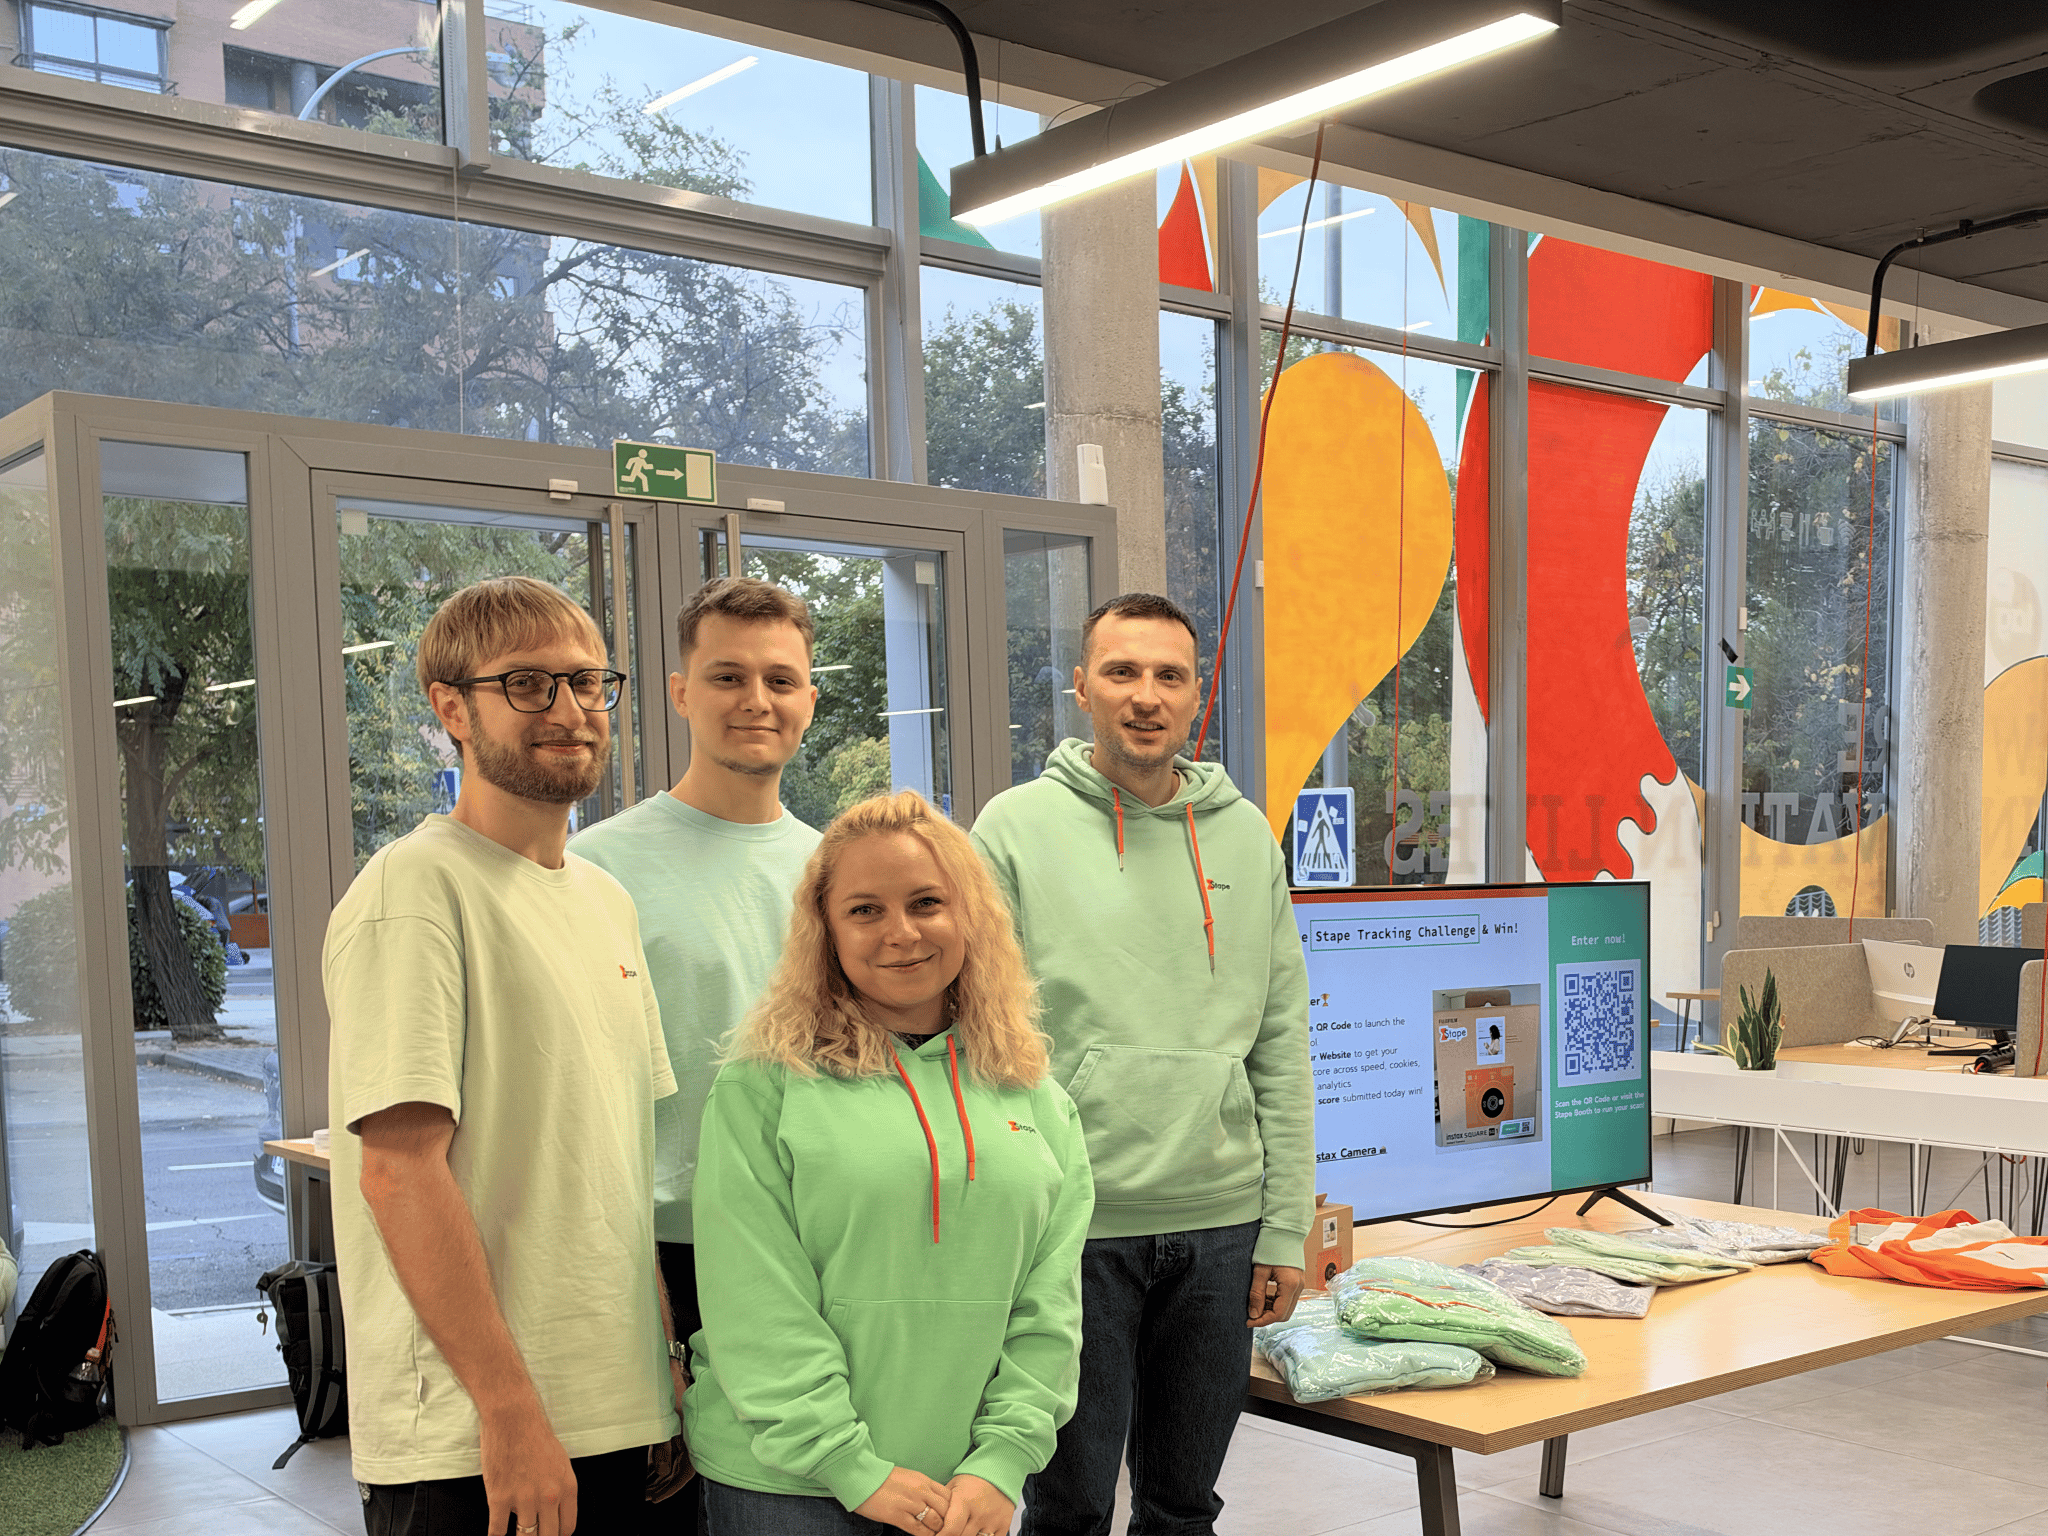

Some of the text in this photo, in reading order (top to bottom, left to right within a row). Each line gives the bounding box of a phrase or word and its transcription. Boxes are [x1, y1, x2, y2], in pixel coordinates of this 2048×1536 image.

[1210, 880, 1230, 891] Stape
[1316, 931, 1350, 944] Stape
[1357, 926, 1411, 942] Tracking
[1418, 925, 1476, 938] Challenge
[1482, 924, 1489, 934] &
[1494, 922, 1518, 934] Win!
[1571, 933, 1626, 946] Enter now!
[1316, 1022, 1328, 1032] QR
[1331, 1020, 1352, 1031] Code
[1354, 1021, 1363, 1029] to
[1365, 1018, 1390, 1028] launch
[1393, 1017, 1406, 1026] the
[1444, 1029, 1467, 1040] Stape
[1319, 1051, 1352, 1061] Website
[1365, 1049, 1378, 1059] get
[1381, 1047, 1398, 1057] your
[1333, 1065, 1358, 1075] across
[1360, 1061, 1387, 1073] speed,
[1389, 1059, 1420, 1069] cookies,
[1317, 1080, 1352, 1091] analytics
[1318, 1087, 1423, 1105] score submitted today win!
[1555, 1100, 1570, 1108] Scan
[1571, 1098, 1582, 1106] the
[1594, 1095, 1611, 1103] Code
[1620, 1092, 1633, 1100] visit
[1634, 1091, 1645, 1099] the
[1555, 1111, 1573, 1119] Stape
[1574, 1108, 1593, 1116] Booth
[1615, 1104, 1629, 1113] your
[1463, 1129, 1488, 1139] SQUARE
[1340, 1147, 1377, 1158] Camera
